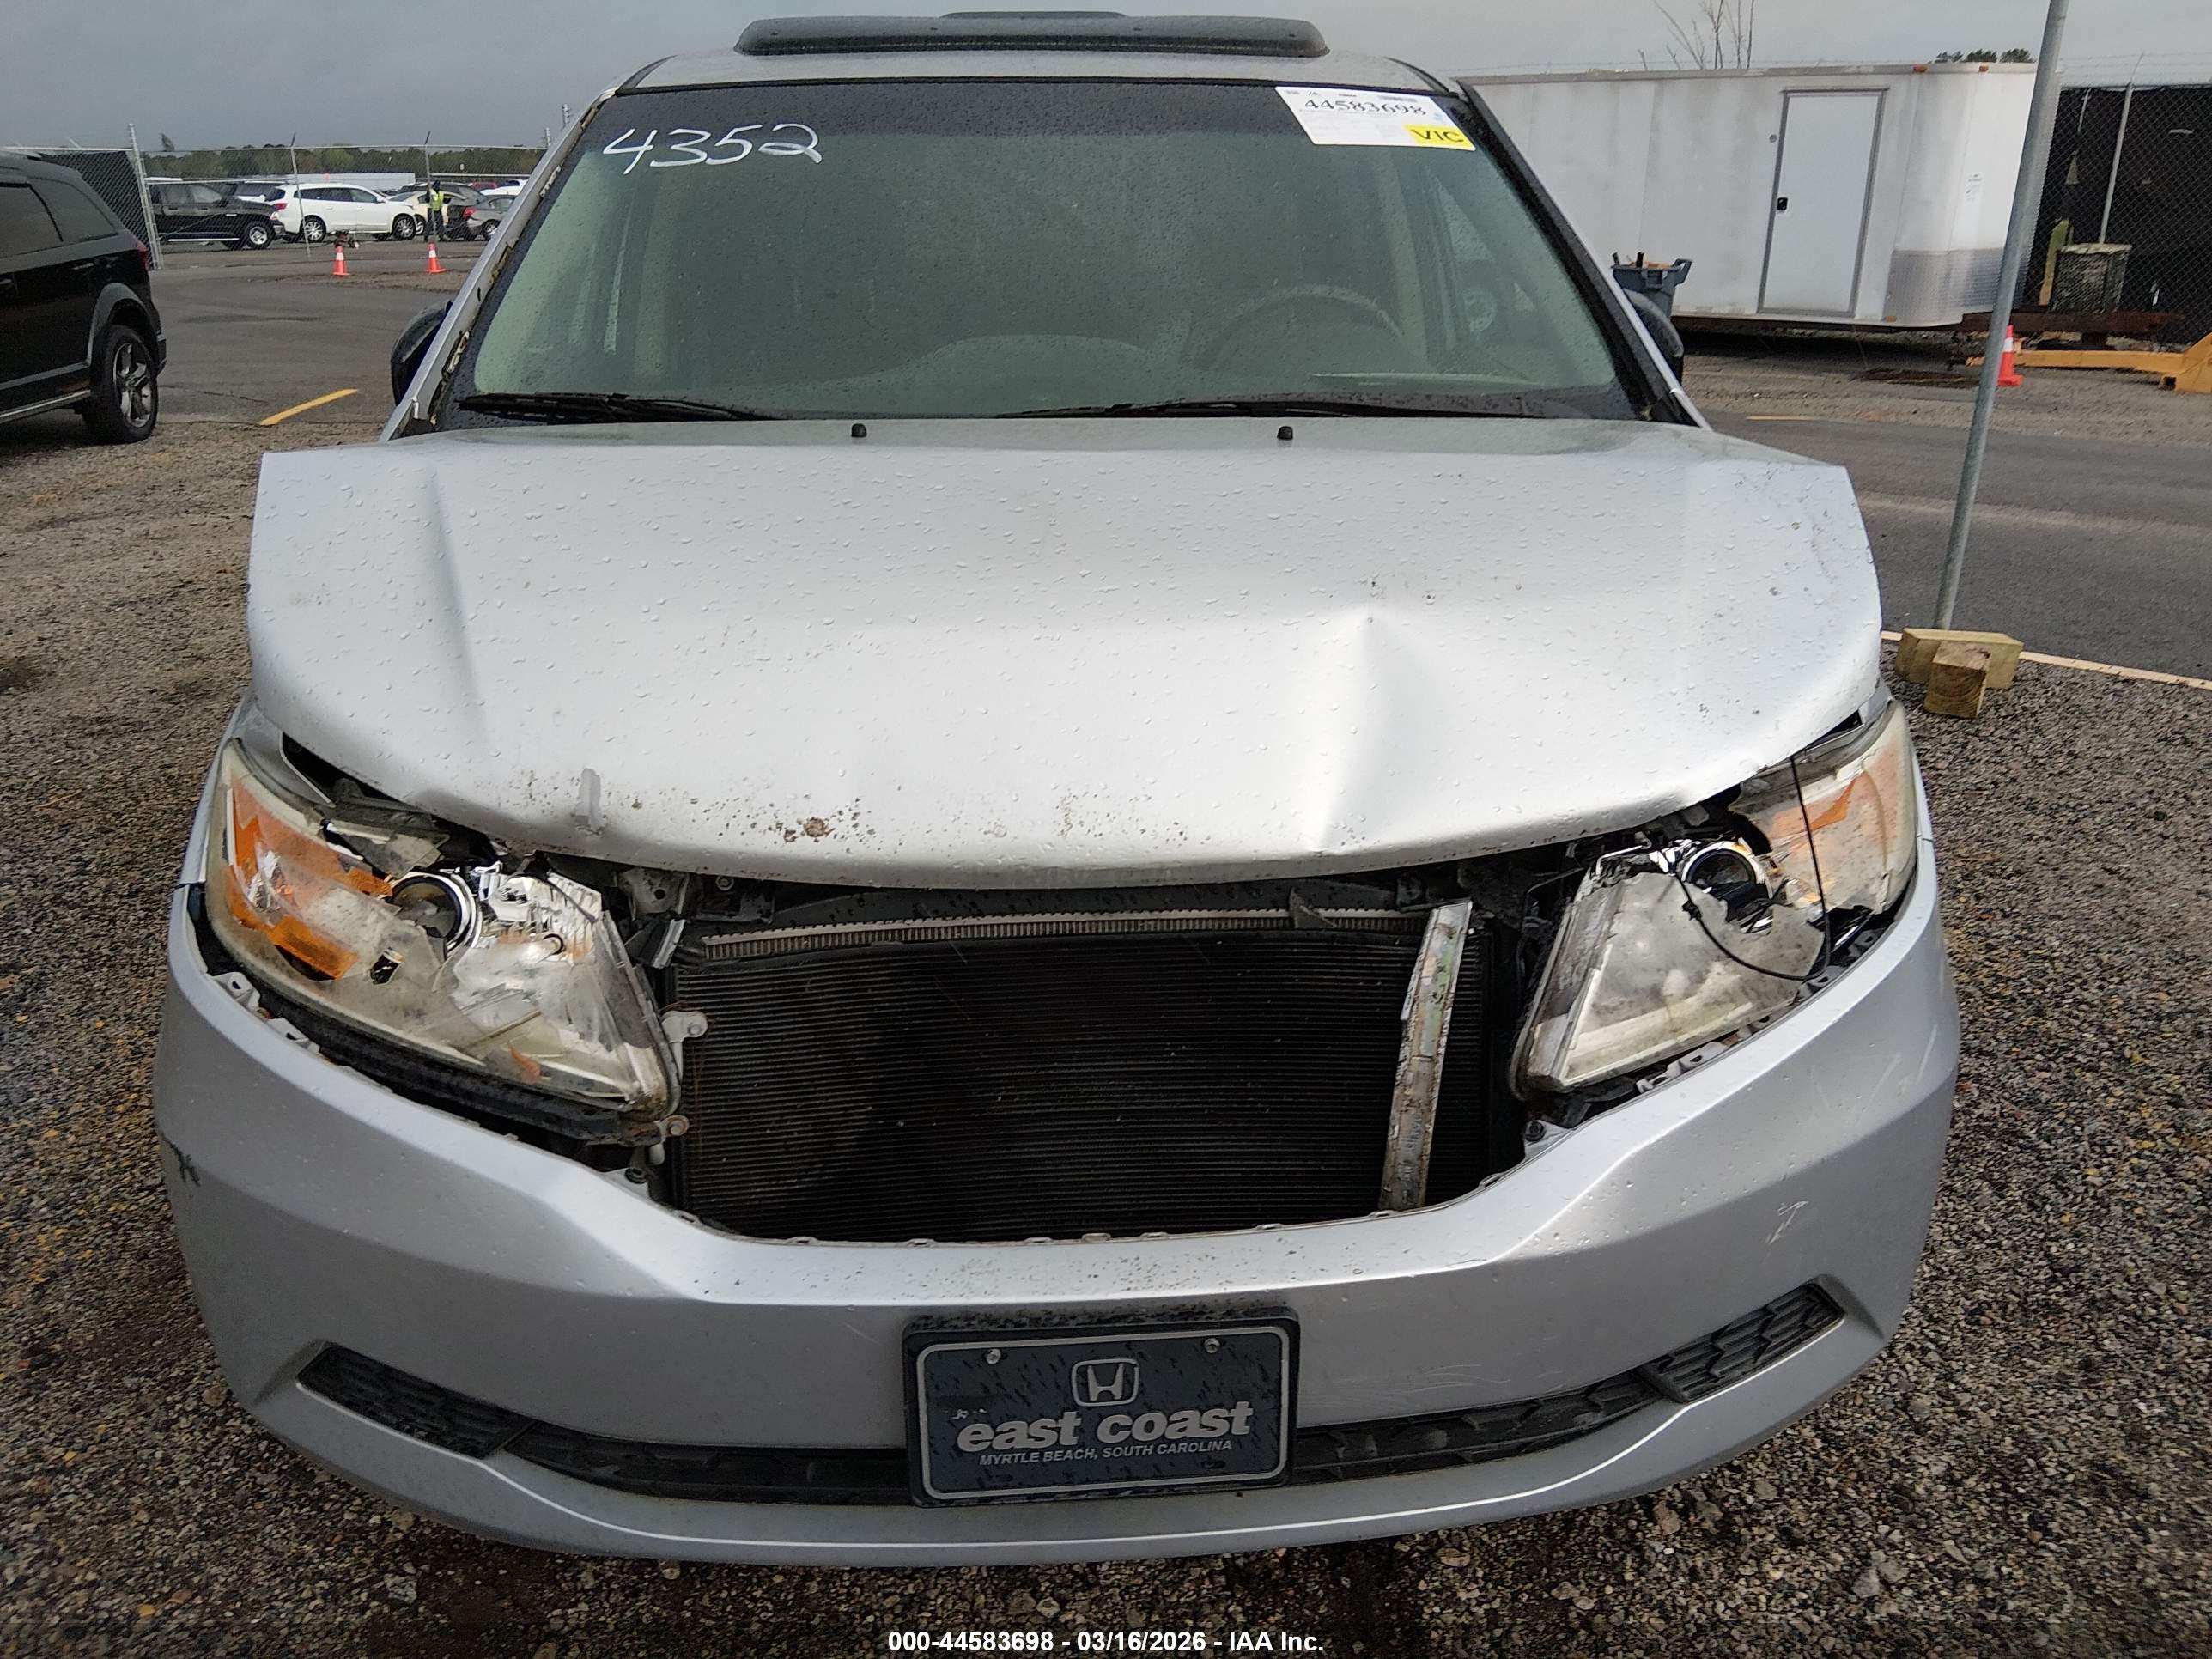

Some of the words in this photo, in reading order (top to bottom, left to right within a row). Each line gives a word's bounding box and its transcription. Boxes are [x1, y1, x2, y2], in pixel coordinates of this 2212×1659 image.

[1304, 99, 1427, 116] 44583698
[1411, 128, 1465, 143] VIC
[603, 123, 823, 175] 4352
[957, 1411, 1082, 1452] east
[1096, 1401, 1254, 1443] coast
[979, 1451, 1041, 1466] MYRTLE
[1042, 1449, 1098, 1462] BEACH,
[1102, 1445, 1153, 1459] SOUTH
[1156, 1440, 1233, 1455] CAROLINA
